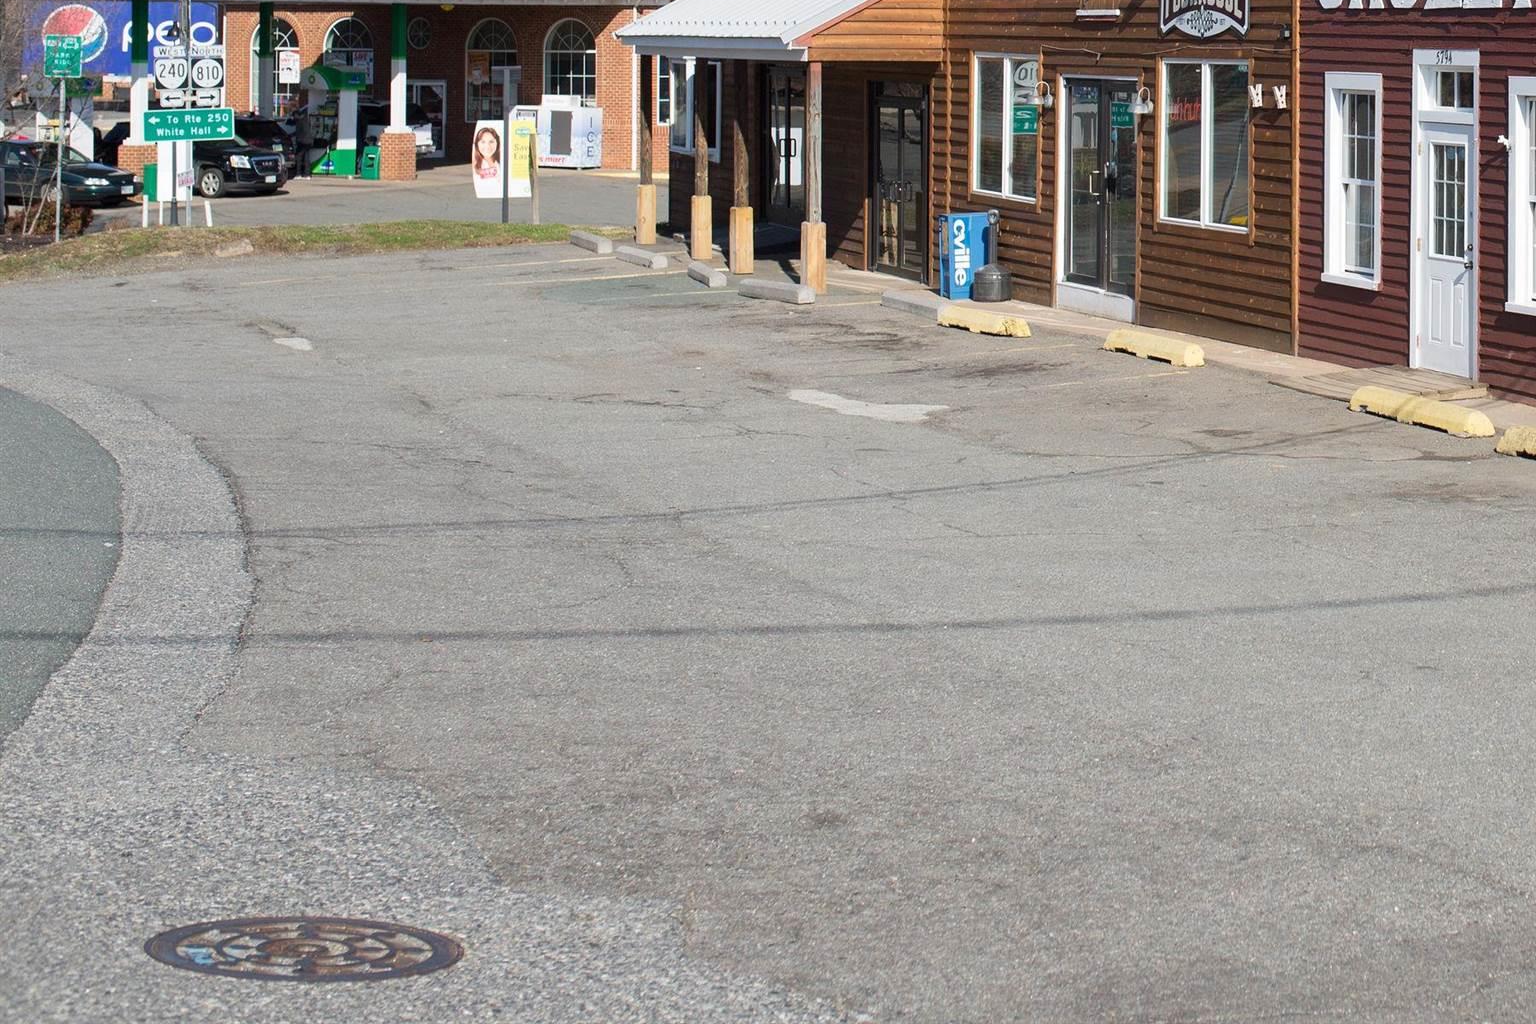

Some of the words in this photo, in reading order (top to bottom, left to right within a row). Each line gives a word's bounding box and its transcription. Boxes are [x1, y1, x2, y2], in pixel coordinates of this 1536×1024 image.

[191, 47, 223, 56] NORTH
[159, 63, 185, 78] 240
[197, 66, 219, 80] 810
[166, 115, 179, 124] To
[184, 114, 202, 124] Rte
[207, 113, 229, 123] 250
[156, 127, 184, 137] White
[190, 126, 211, 135] Hall
[586, 116, 595, 158] ICE
[953, 218, 971, 287] cville
